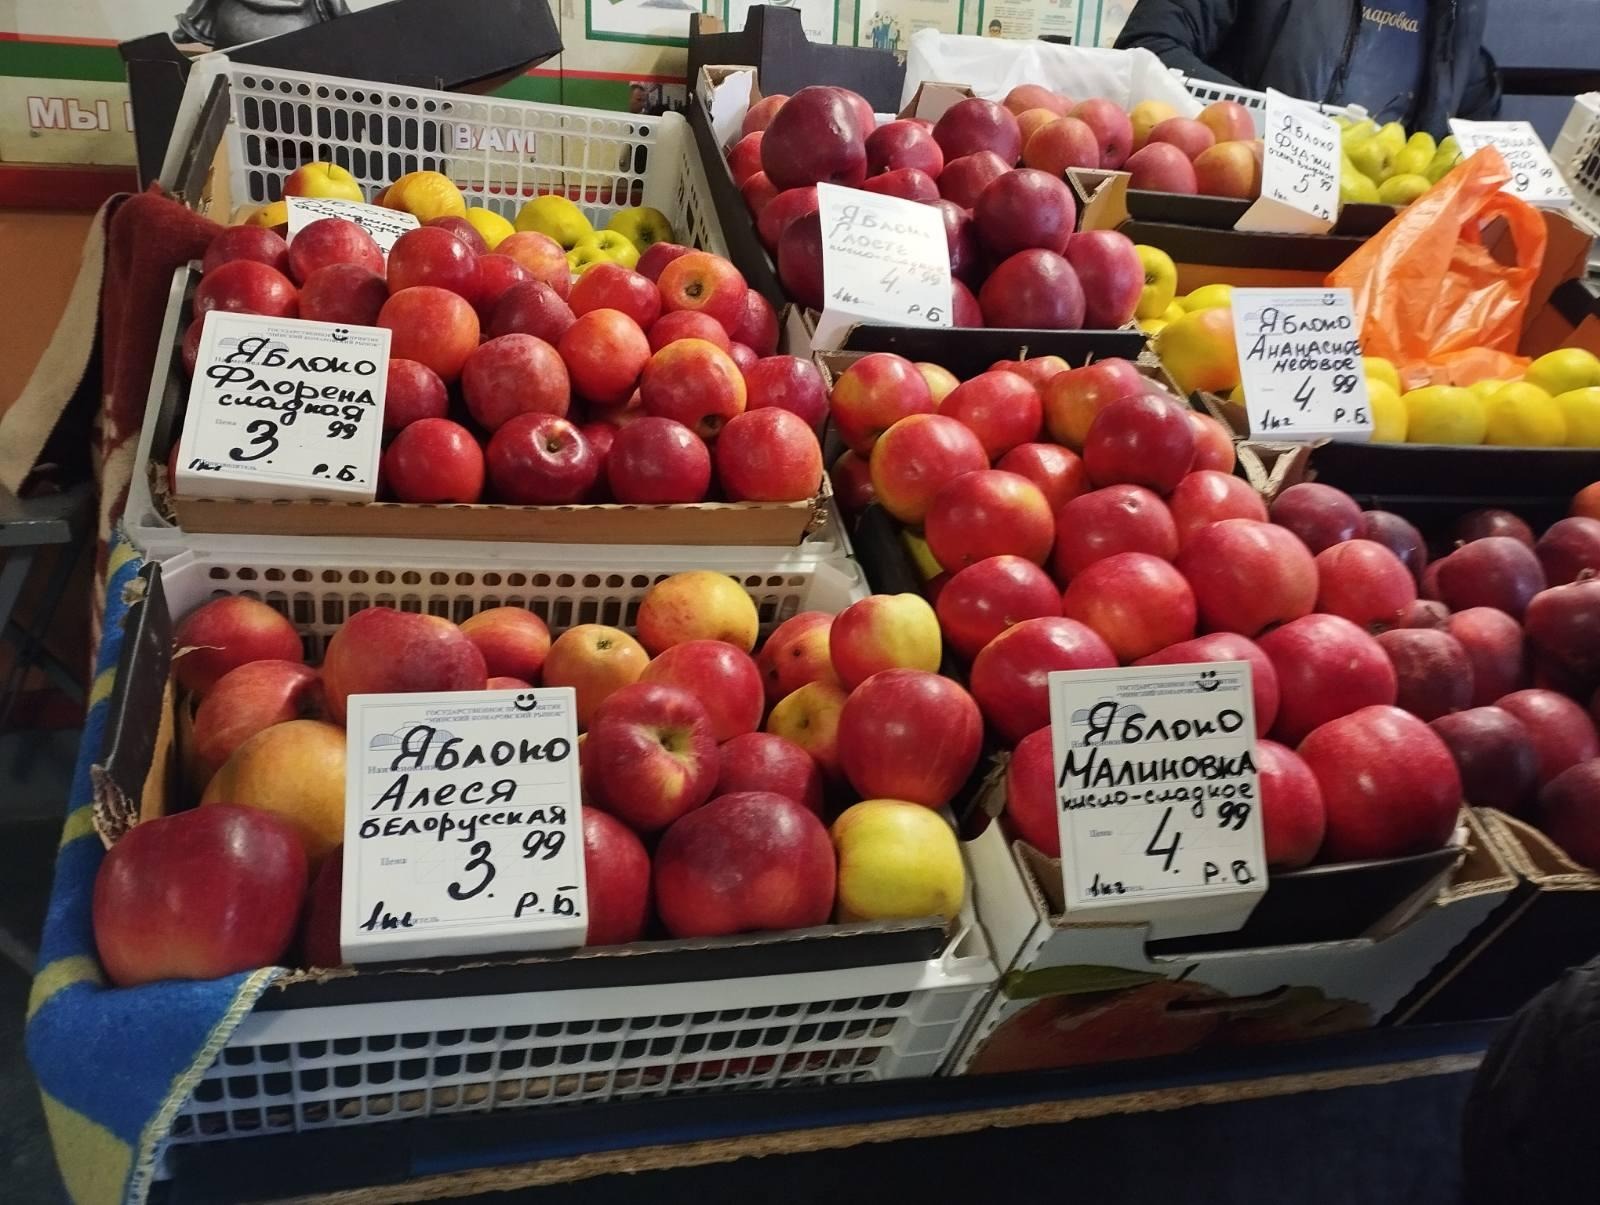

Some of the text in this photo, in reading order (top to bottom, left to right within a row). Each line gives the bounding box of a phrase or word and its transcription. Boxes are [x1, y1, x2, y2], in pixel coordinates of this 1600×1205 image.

[27, 96, 111, 131] МЫ
[455, 123, 536, 154] ВАМ
[1282, 115, 1335, 152] Яблоко
[1259, 307, 1351, 334] Яблоко
[225, 337, 377, 376] Яблоко
[1332, 374, 1358, 394] 99
[218, 394, 365, 426] сладкая
[1260, 409, 1294, 431] 1кг
[326, 420, 358, 440] 99
[1083, 701, 1244, 747] Яблоко
[391, 724, 571, 771] Яблоко
[371, 774, 517, 811] Алеся
[1061, 782, 1254, 818] кисло-сладкое
[1218, 800, 1251, 831] 99
[522, 830, 566, 861] 99
[360, 901, 414, 931] 1кг
